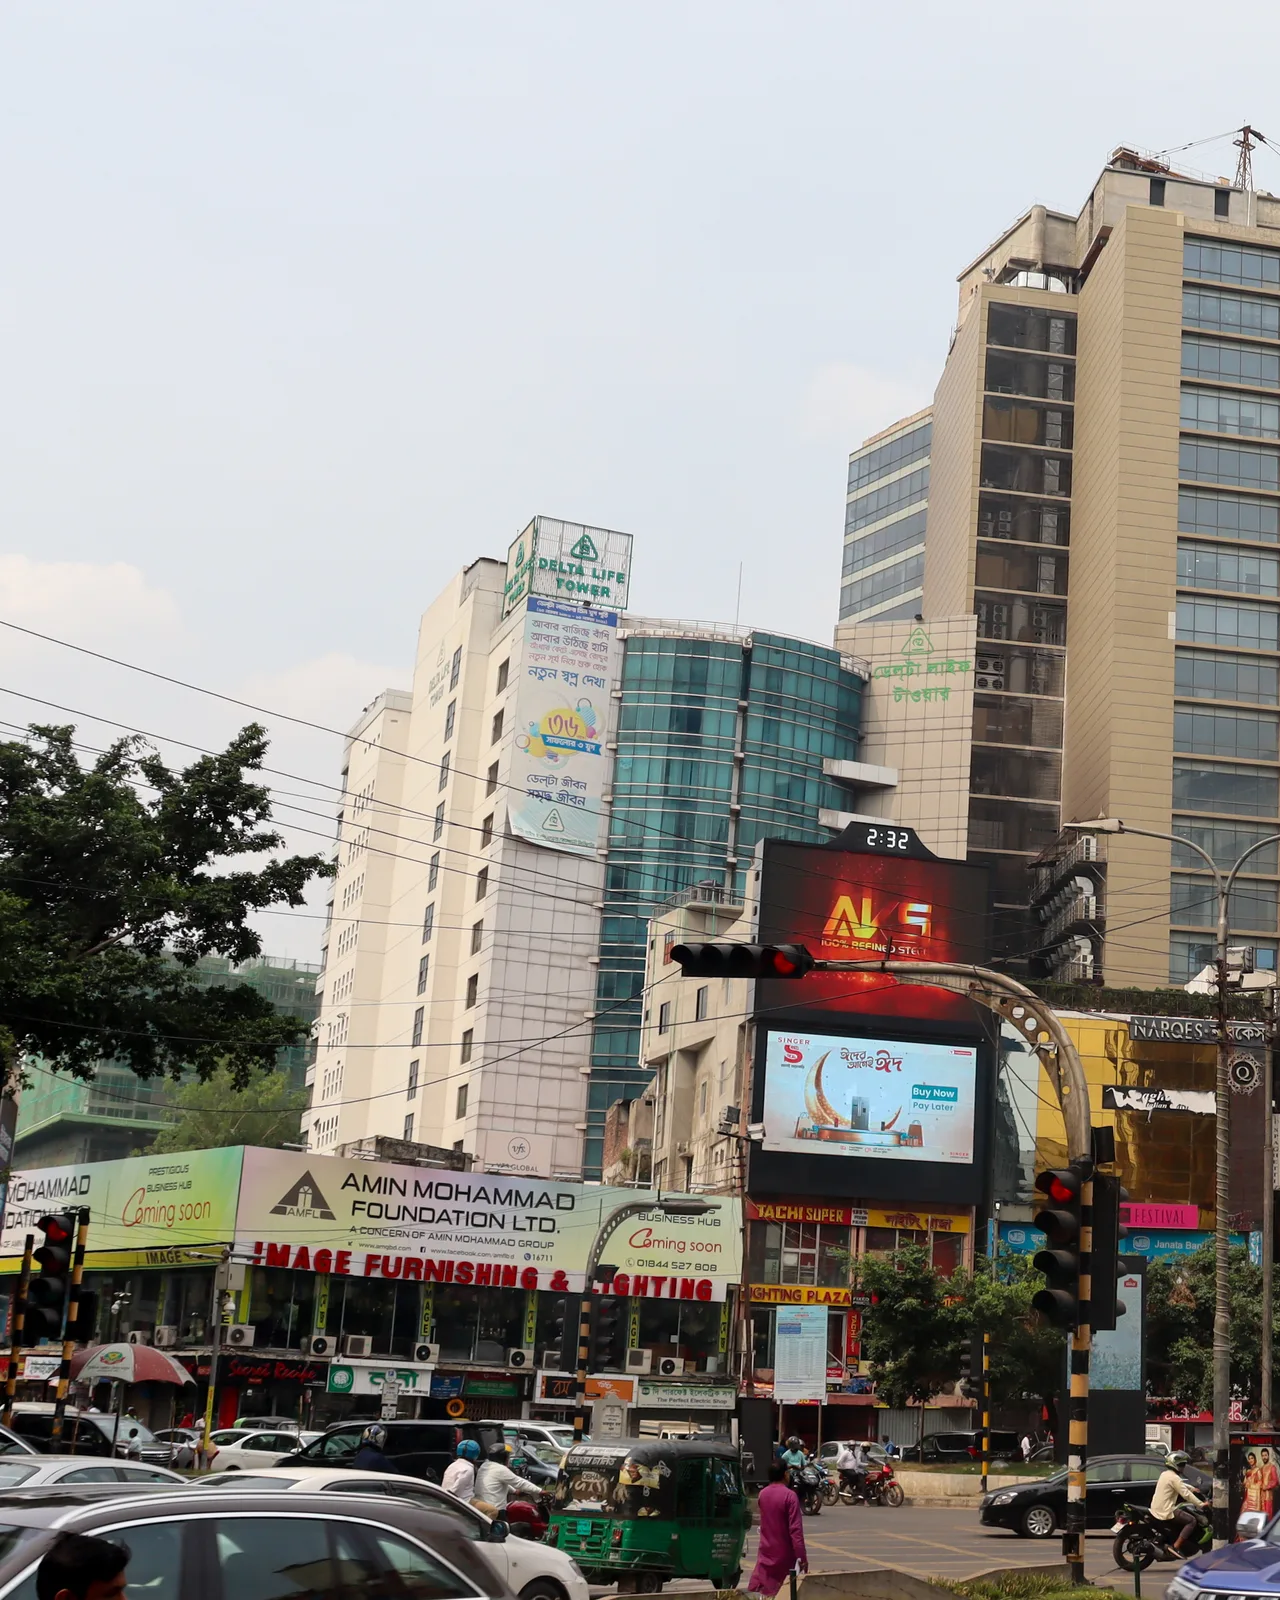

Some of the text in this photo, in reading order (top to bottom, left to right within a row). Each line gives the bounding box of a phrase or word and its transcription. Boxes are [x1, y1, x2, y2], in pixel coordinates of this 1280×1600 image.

[538, 557, 625, 584] DELTA LIFE
[556, 577, 611, 598] TOWER
[532, 620, 559, 631] আবার
[562, 624, 590, 638] বাজিছে
[530, 632, 609, 653] আবার উঠিছে হাসি
[927, 659, 972, 676] লাইফ
[528, 665, 606, 689] নতুন স্বপ্ন দেখা
[893, 684, 951, 704] টাওয়ার
[526, 773, 587, 791] ডেল্টা জীবন
[556, 789, 586, 807] জীবন
[866, 828, 909, 850] 2:32
[821, 938, 849, 949] 100%
[1133, 1019, 1203, 1040] NARQES
[778, 1036, 810, 1045] SINGER
[875, 1049, 904, 1073] ঈদ
[913, 1087, 955, 1098] Buy Now
[913, 1101, 954, 1112] Pay Later
[148, 1164, 190, 1176] PRESTIGIOUS
[511, 1163, 539, 1172] GLOBAL
[146, 1180, 192, 1193] BUSINESS HUB
[340, 1172, 576, 1212] AMIN MOHAMMAD
[122, 1187, 211, 1228] Coming soon
[286, 1207, 320, 1219] AMFL
[757, 1203, 844, 1223] TACHI SUPER
[1135, 1207, 1186, 1225] FESTIVAL
[351, 1200, 561, 1234] FOUNDATION LTD.
[638, 1213, 721, 1227] BUSINESS HUB
[349, 1225, 555, 1250] A CONCERN OF AMIN MOHAMMAD GROUP
[628, 1228, 722, 1254] Coming soon
[1155, 1239, 1201, 1251] Janata Ban
[146, 1250, 182, 1265] IMAGE
[253, 1241, 352, 1274] IMAGE
[364, 1254, 538, 1290] FURNISHING
[550, 1270, 569, 1291] &
[532, 1253, 553, 1262] 16711
[636, 1259, 717, 1272] 01844 527 808
[749, 1286, 852, 1304] IGHTING PLAZA
